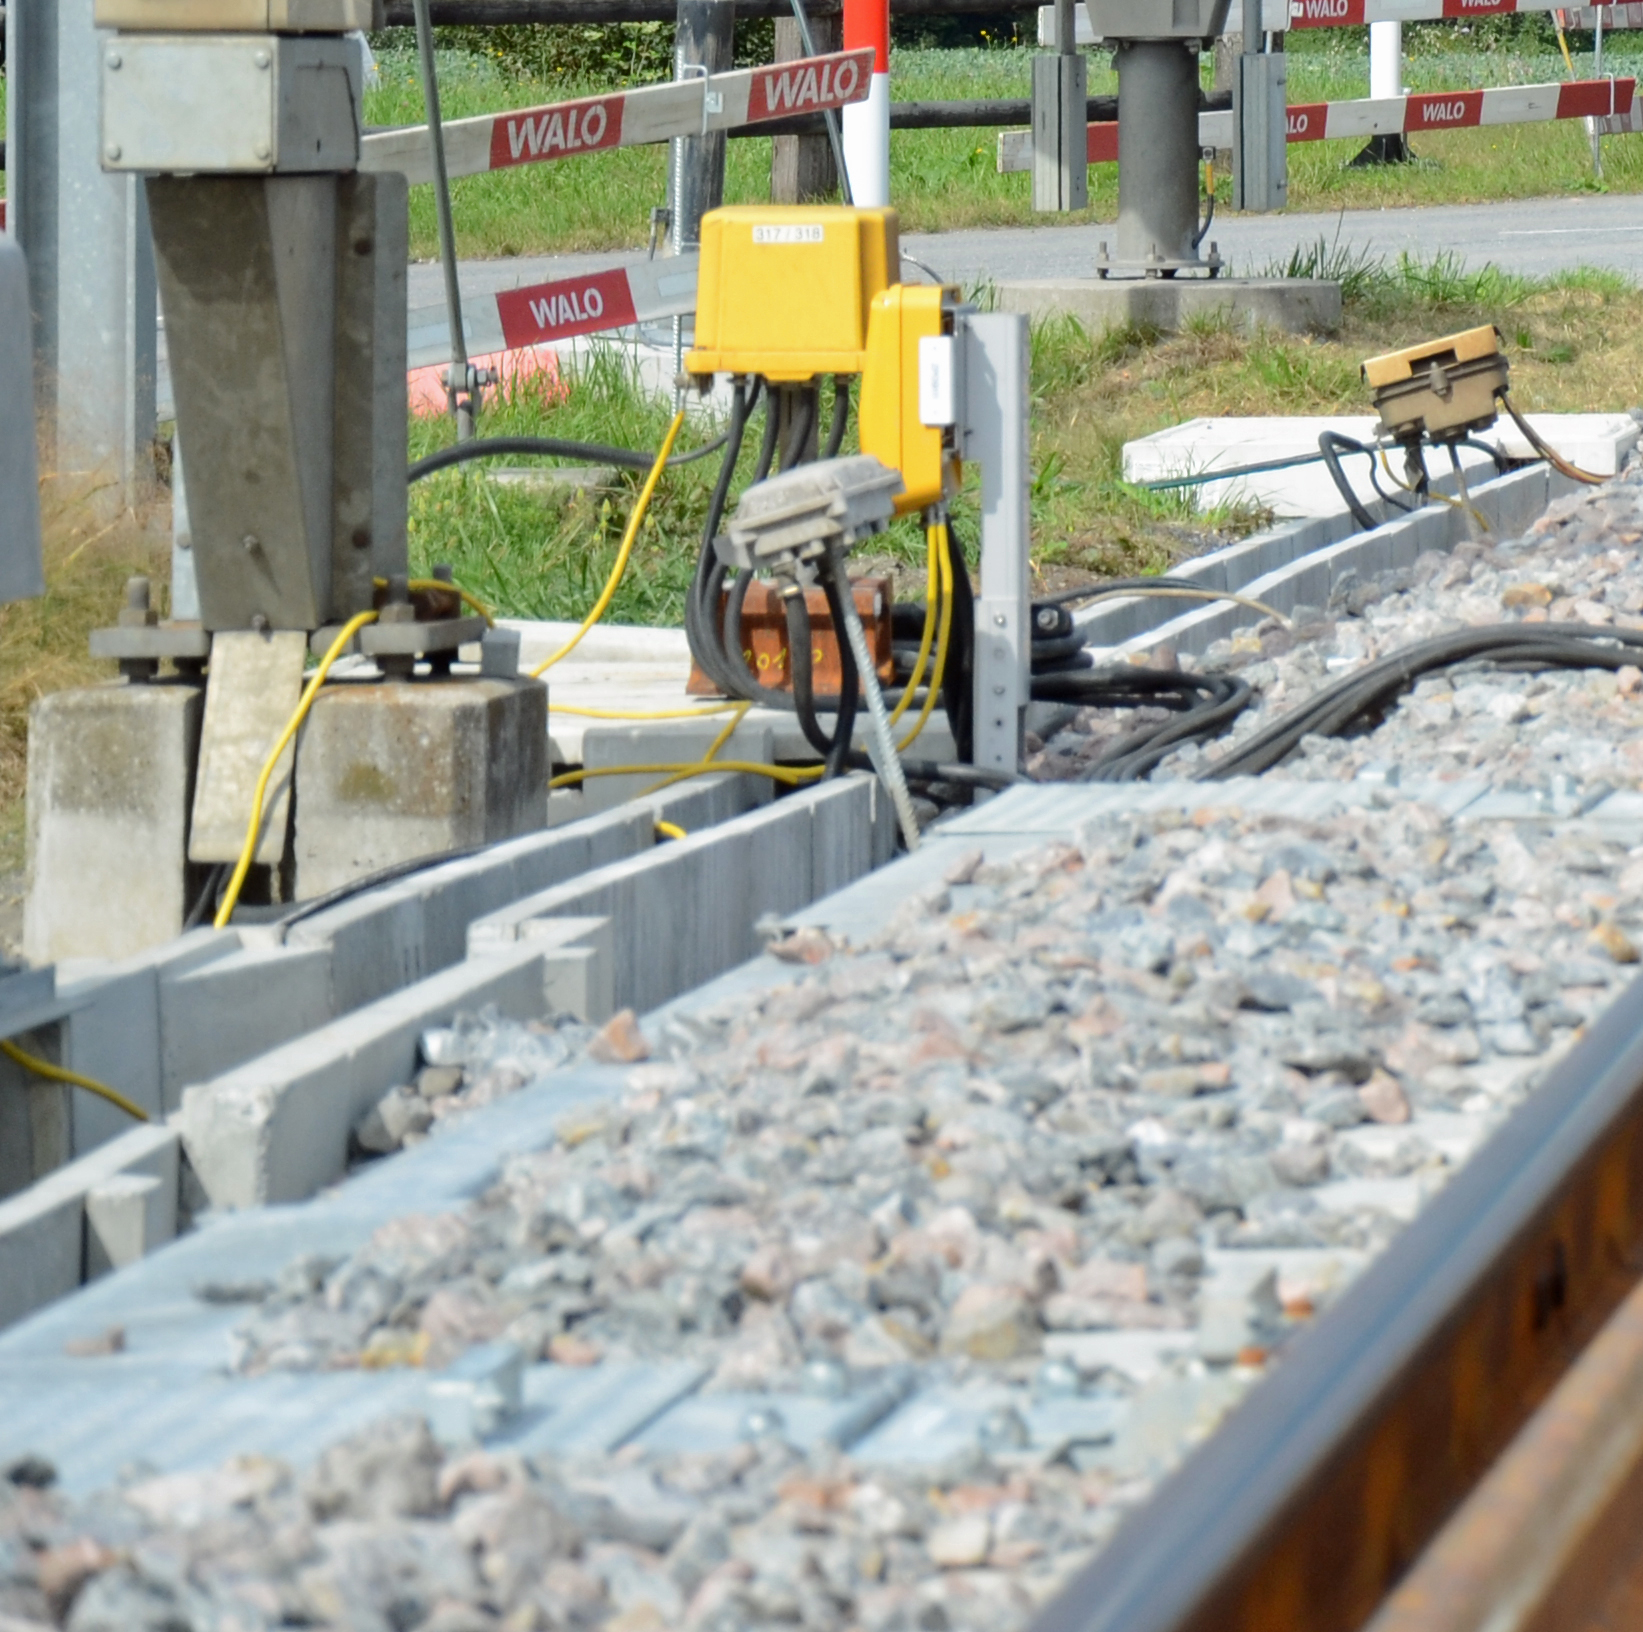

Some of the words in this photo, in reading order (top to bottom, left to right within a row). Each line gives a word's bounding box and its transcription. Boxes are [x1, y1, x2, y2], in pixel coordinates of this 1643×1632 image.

[765, 59, 859, 112] WALO
[507, 104, 607, 159] WALO
[1423, 101, 1465, 123] WALO
[529, 286, 604, 330] WALO
